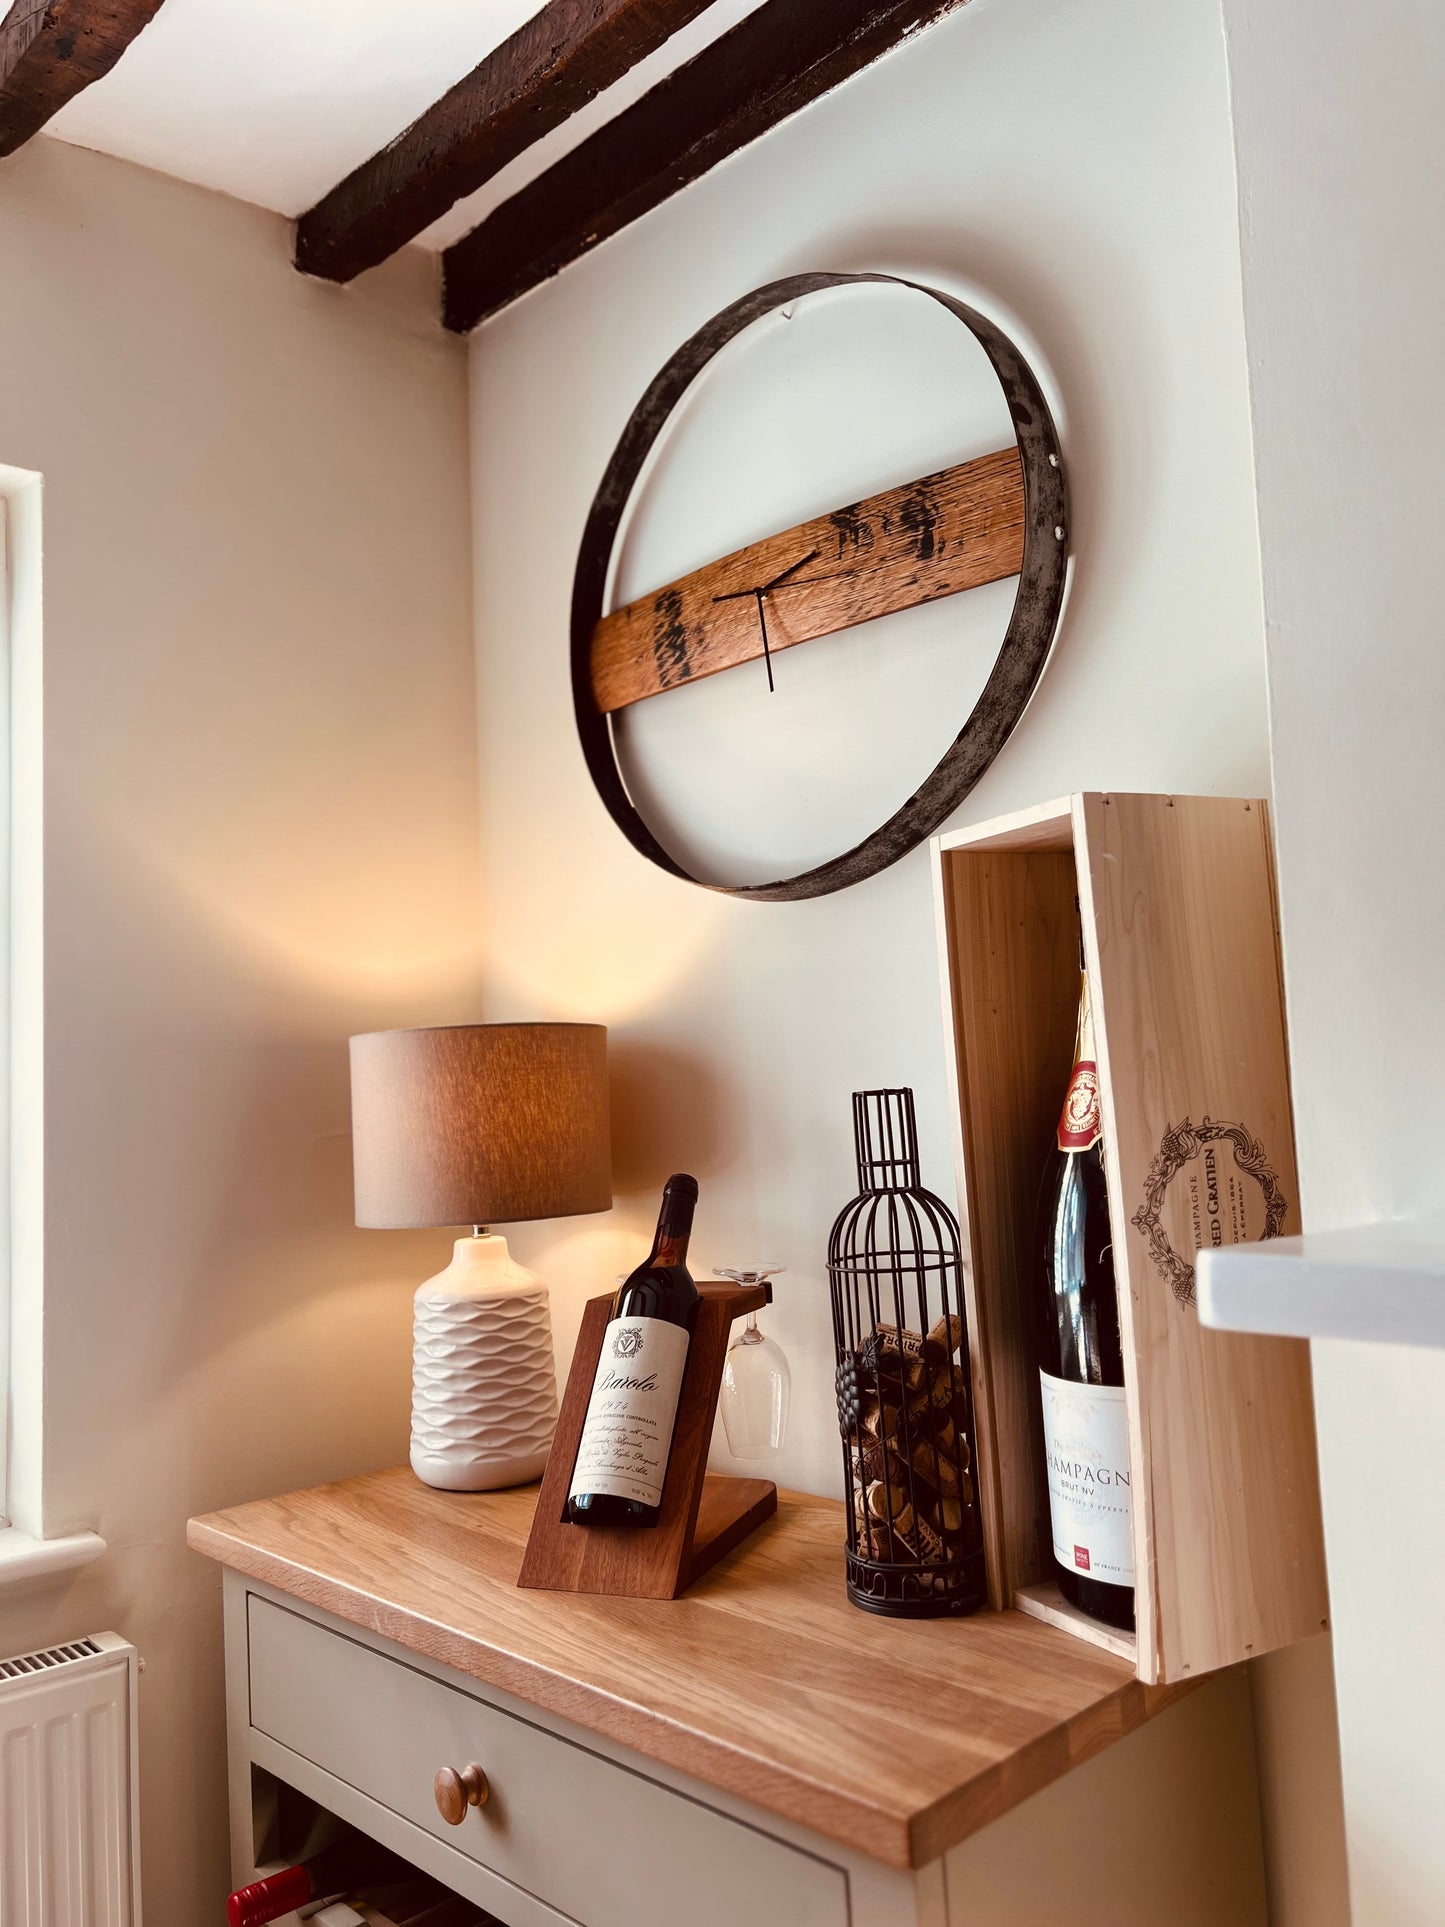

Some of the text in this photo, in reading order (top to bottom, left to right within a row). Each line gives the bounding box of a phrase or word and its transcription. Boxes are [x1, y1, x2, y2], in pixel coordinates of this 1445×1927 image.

[1204, 1148, 1219, 1215] GRATIEN
[594, 1368, 661, 1395] Barolo
[626, 1413, 657, 1427] CONTROLLATA
[1061, 1479, 1079, 1492] BRUT
[1082, 1486, 1095, 1496] NV
